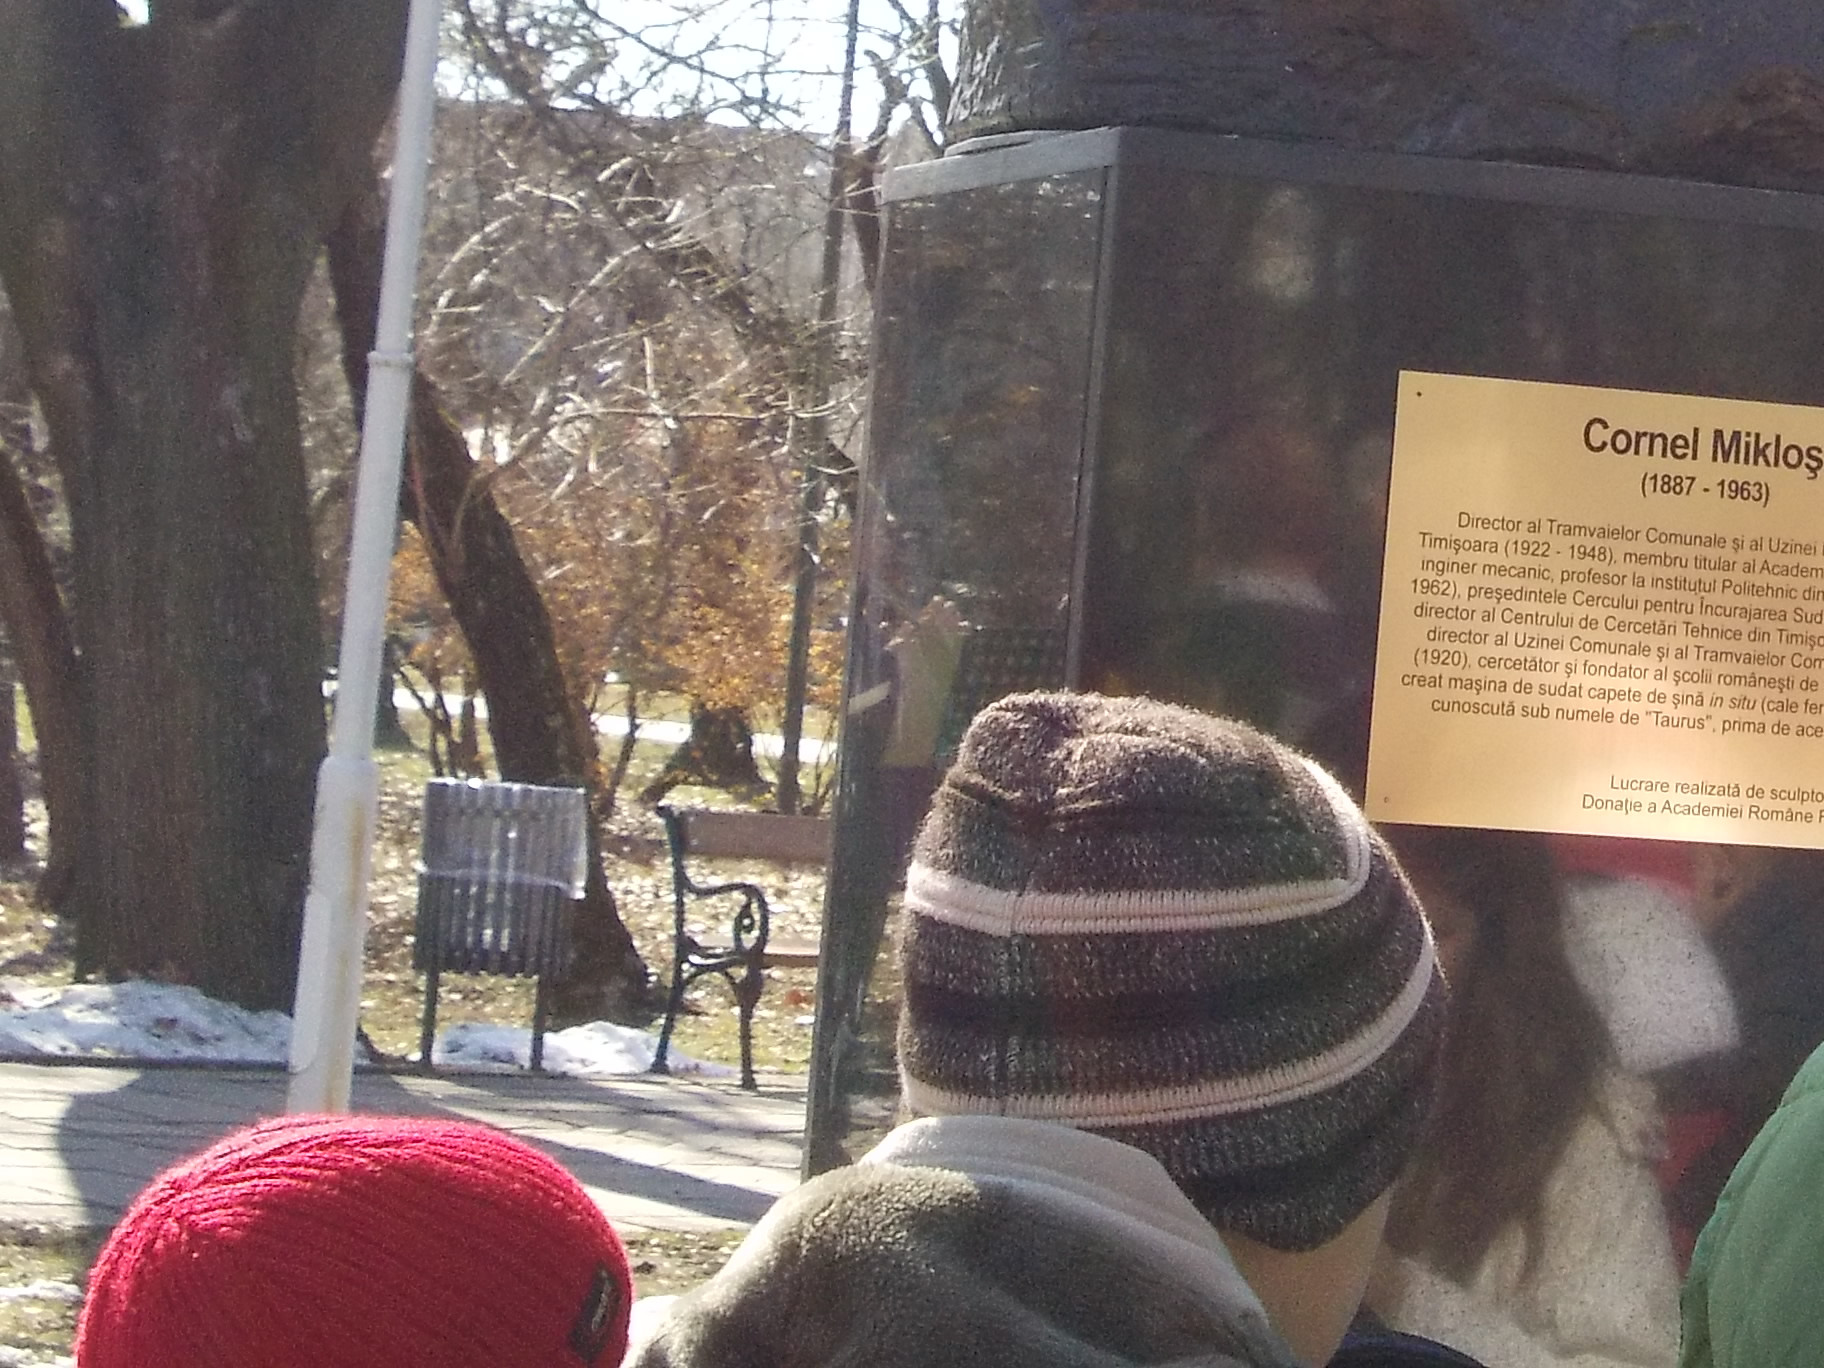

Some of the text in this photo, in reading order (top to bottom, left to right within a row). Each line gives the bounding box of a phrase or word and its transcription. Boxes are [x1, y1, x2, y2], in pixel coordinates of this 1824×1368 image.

[1583, 417, 1700, 461] Cornel
[1641, 471, 1697, 498] (1887
[1716, 478, 1770, 508] 1963)
[1457, 511, 1523, 533] Director
[1526, 517, 1542, 534] al
[1546, 518, 1642, 542] Tramvaielor
[1645, 527, 1727, 549] Comunale
[1749, 536, 1764, 552] al
[1768, 536, 1817, 556] Uzinei
[1504, 539, 1551, 559] (1922
[1623, 551, 1689, 569] membru
[1694, 554, 1737, 572] titular
[1742, 558, 1756, 574] al
[1421, 559, 1478, 578] inginer
[1560, 567, 1628, 586] profesor
[1631, 571, 1646, 588] la
[1721, 578, 1798, 600] Politehnic
[1413, 601, 1477, 621] director
[1481, 606, 1496, 623] al
[1500, 607, 1574, 629] Centrului
[1578, 613, 1599, 631] de
[1682, 620, 1743, 642] Tehnice
[1747, 626, 1771, 643] din
[1572, 589, 1639, 611] Cercului
[1643, 598, 1695, 616] pentru
[1699, 596, 1788, 623] Încurajarea
[1426, 625, 1490, 645] director
[1494, 630, 1509, 647] al
[1514, 631, 1565, 651] Uzinei
[1569, 635, 1652, 658] Comunale
[1674, 644, 1689, 660] al
[1693, 644, 1787, 667] Tramvaielor
[1401, 673, 1443, 689] creat
[1512, 677, 1534, 695] de
[1537, 681, 1583, 699] sudat
[1587, 686, 1642, 705] capete
[1646, 687, 1667, 705] de
[1708, 692, 1724, 709] in
[1728, 694, 1757, 711] situ
[1760, 696, 1799, 716] (cale
[1582, 659, 1650, 680] fondator
[1653, 665, 1668, 682] al
[1799, 675, 1819, 693] de
[1520, 702, 1551, 720] sub
[1555, 706, 1615, 724] numele
[1619, 708, 1640, 726] de
[1721, 719, 1766, 736] prima
[1770, 719, 1791, 736] de
[1610, 774, 1670, 793] Lucrare
[1745, 783, 1766, 800] de
[1647, 801, 1657, 814] a
[1660, 799, 1744, 819] Academiei
[1747, 804, 1814, 824] Române
